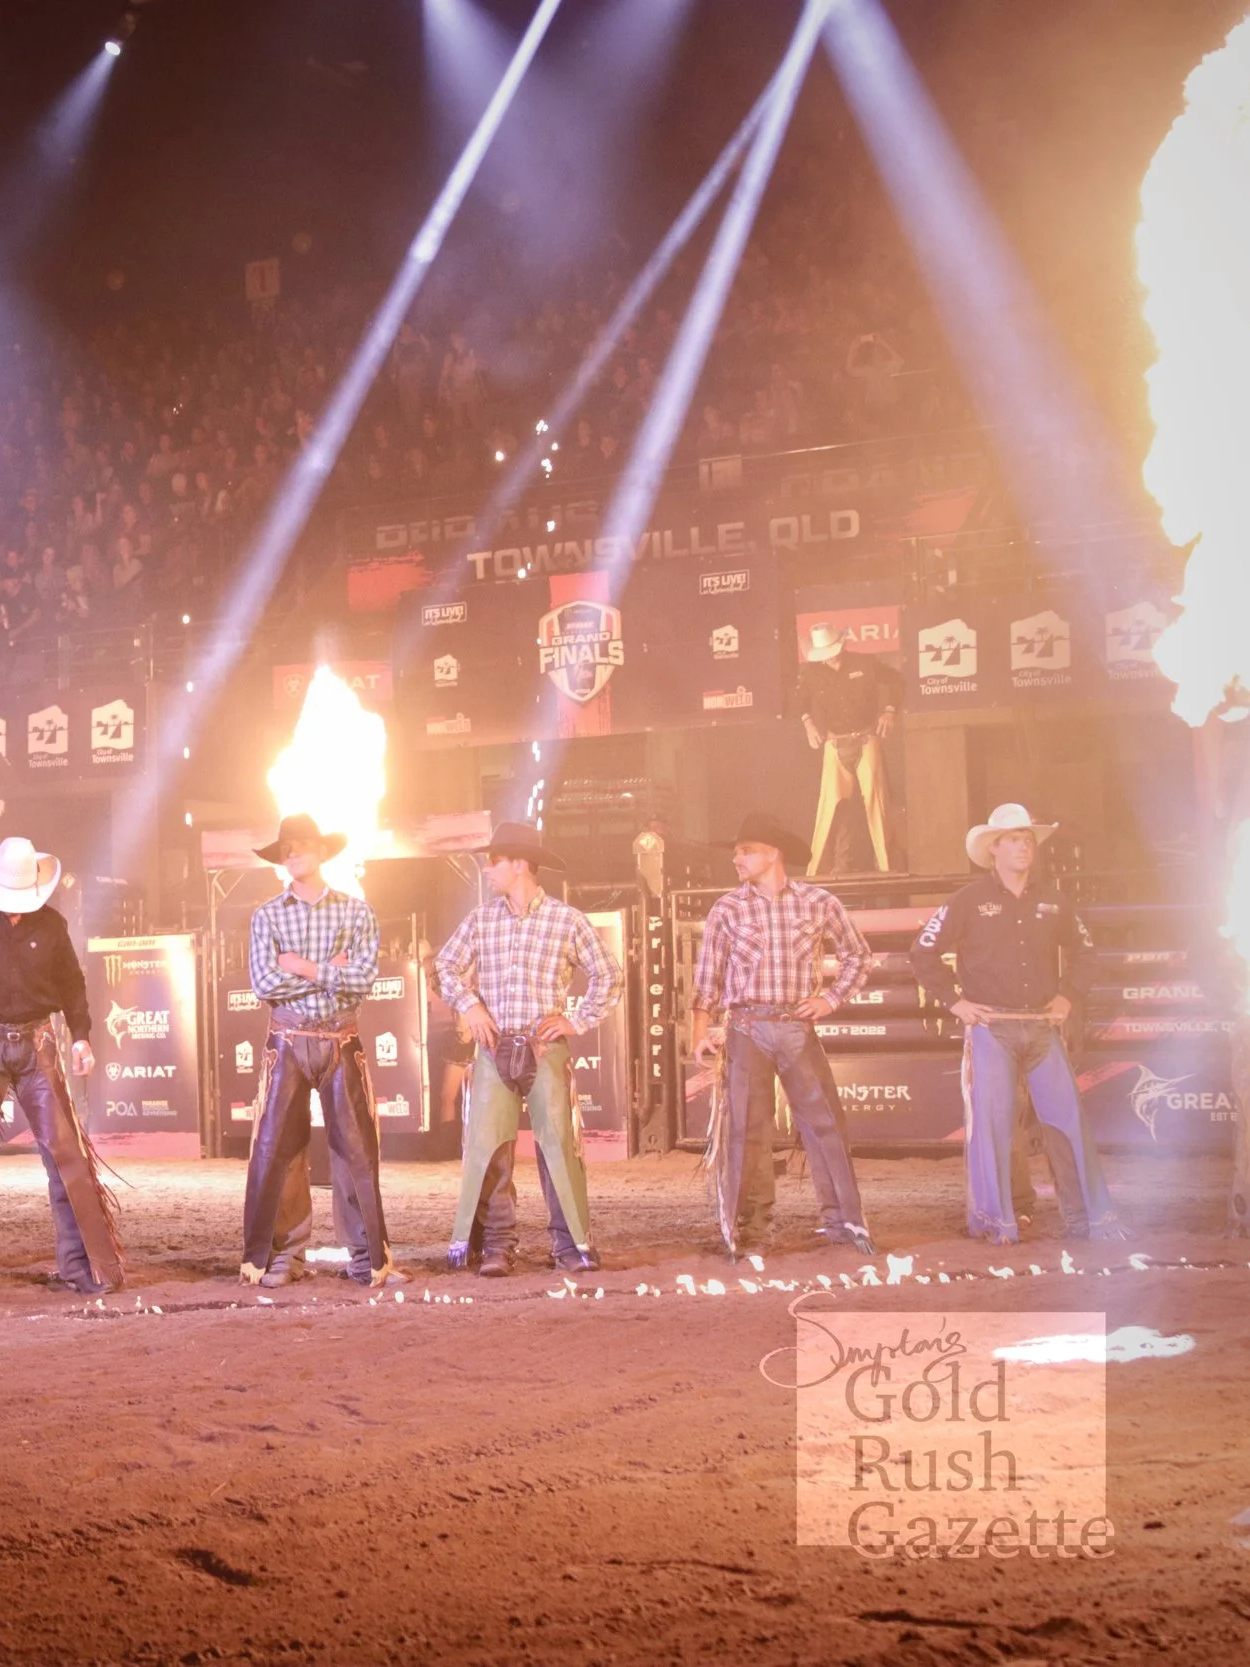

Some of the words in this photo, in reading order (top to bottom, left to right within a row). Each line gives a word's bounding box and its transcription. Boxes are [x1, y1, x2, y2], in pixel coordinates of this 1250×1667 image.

[769, 508, 860, 551] QLD
[552, 631, 612, 646] GRAND
[539, 640, 625, 675] FINALS
[919, 680, 979, 696] Townsville
[1011, 673, 1073, 689] Townsville
[127, 1010, 171, 1025] GREAT
[850, 1025, 886, 1036] 2022
[121, 1065, 178, 1079] ARIAT
[106, 1100, 138, 1118] POA
[1166, 1091, 1238, 1111] GREA
